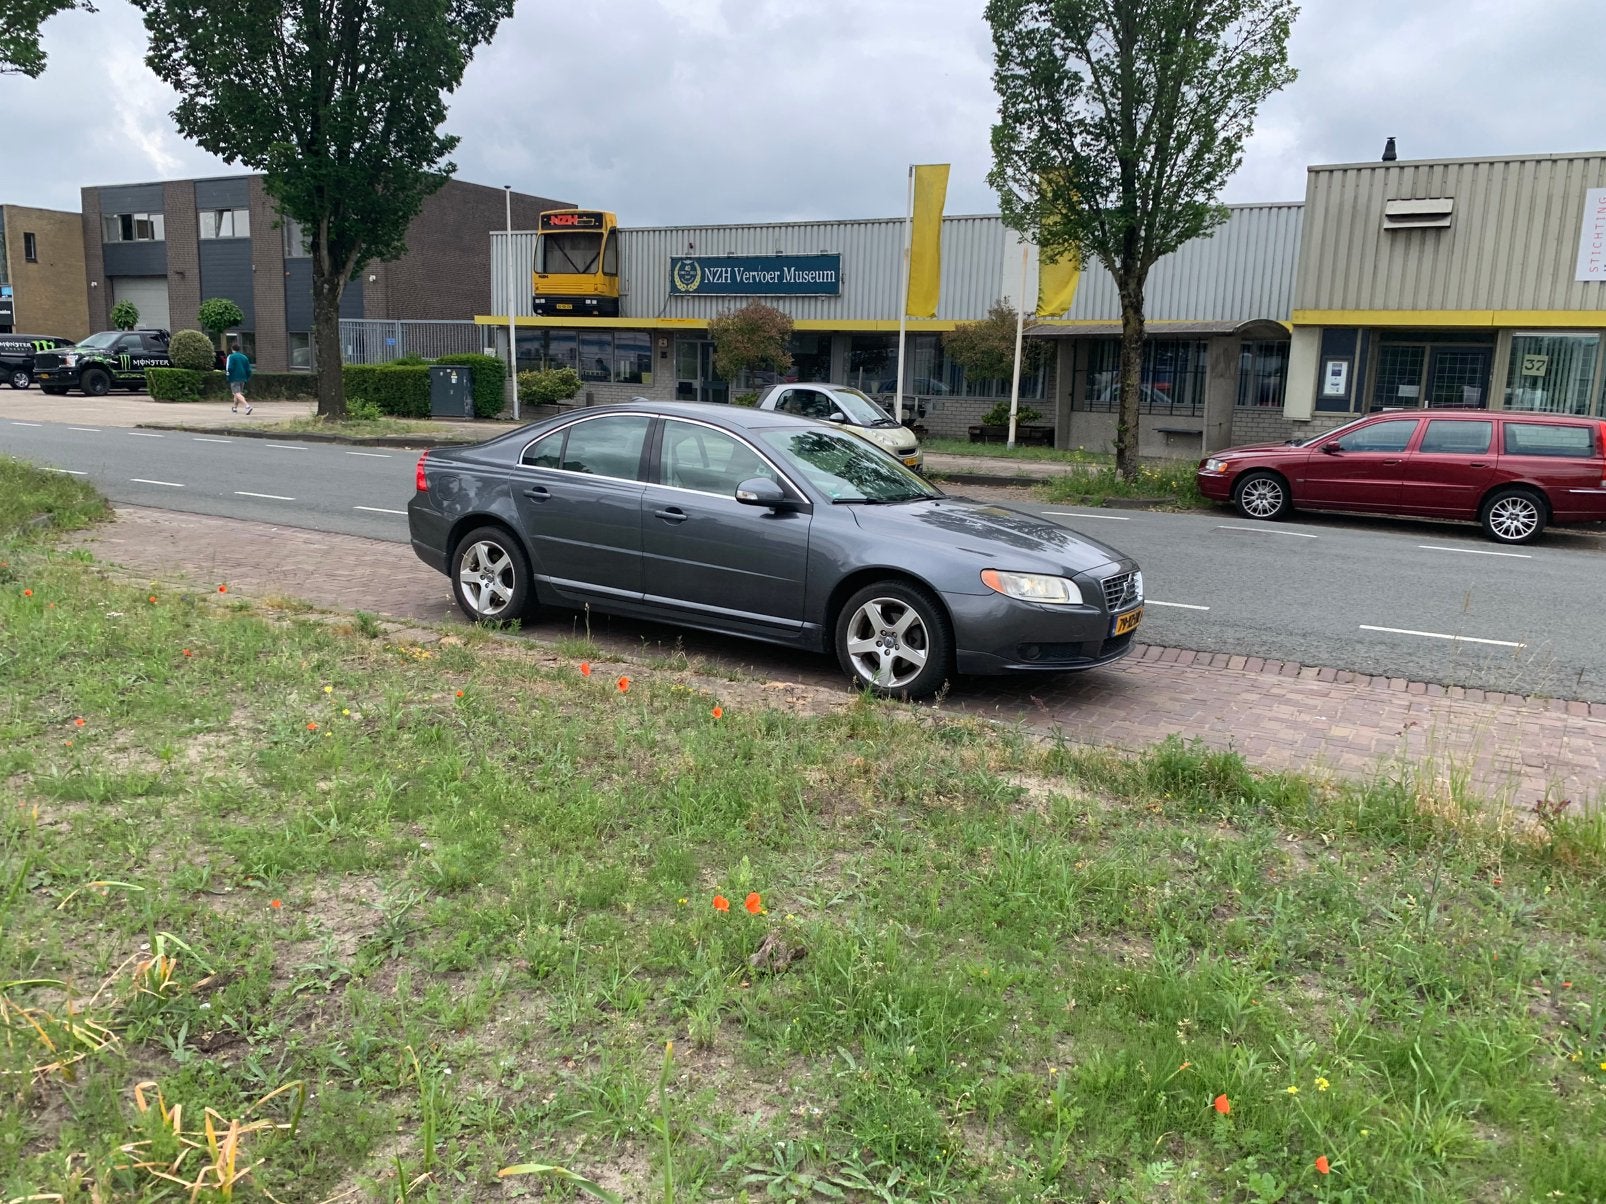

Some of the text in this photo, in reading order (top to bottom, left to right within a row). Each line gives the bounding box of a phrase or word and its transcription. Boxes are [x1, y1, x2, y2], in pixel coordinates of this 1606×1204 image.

[550, 215, 578, 225] NZH
[1589, 197, 1606, 272] STICHTING
[704, 267, 835, 283] NZH Vervoer Museum
[133, 358, 170, 366] MONSTER
[1525, 359, 1546, 371] 37
